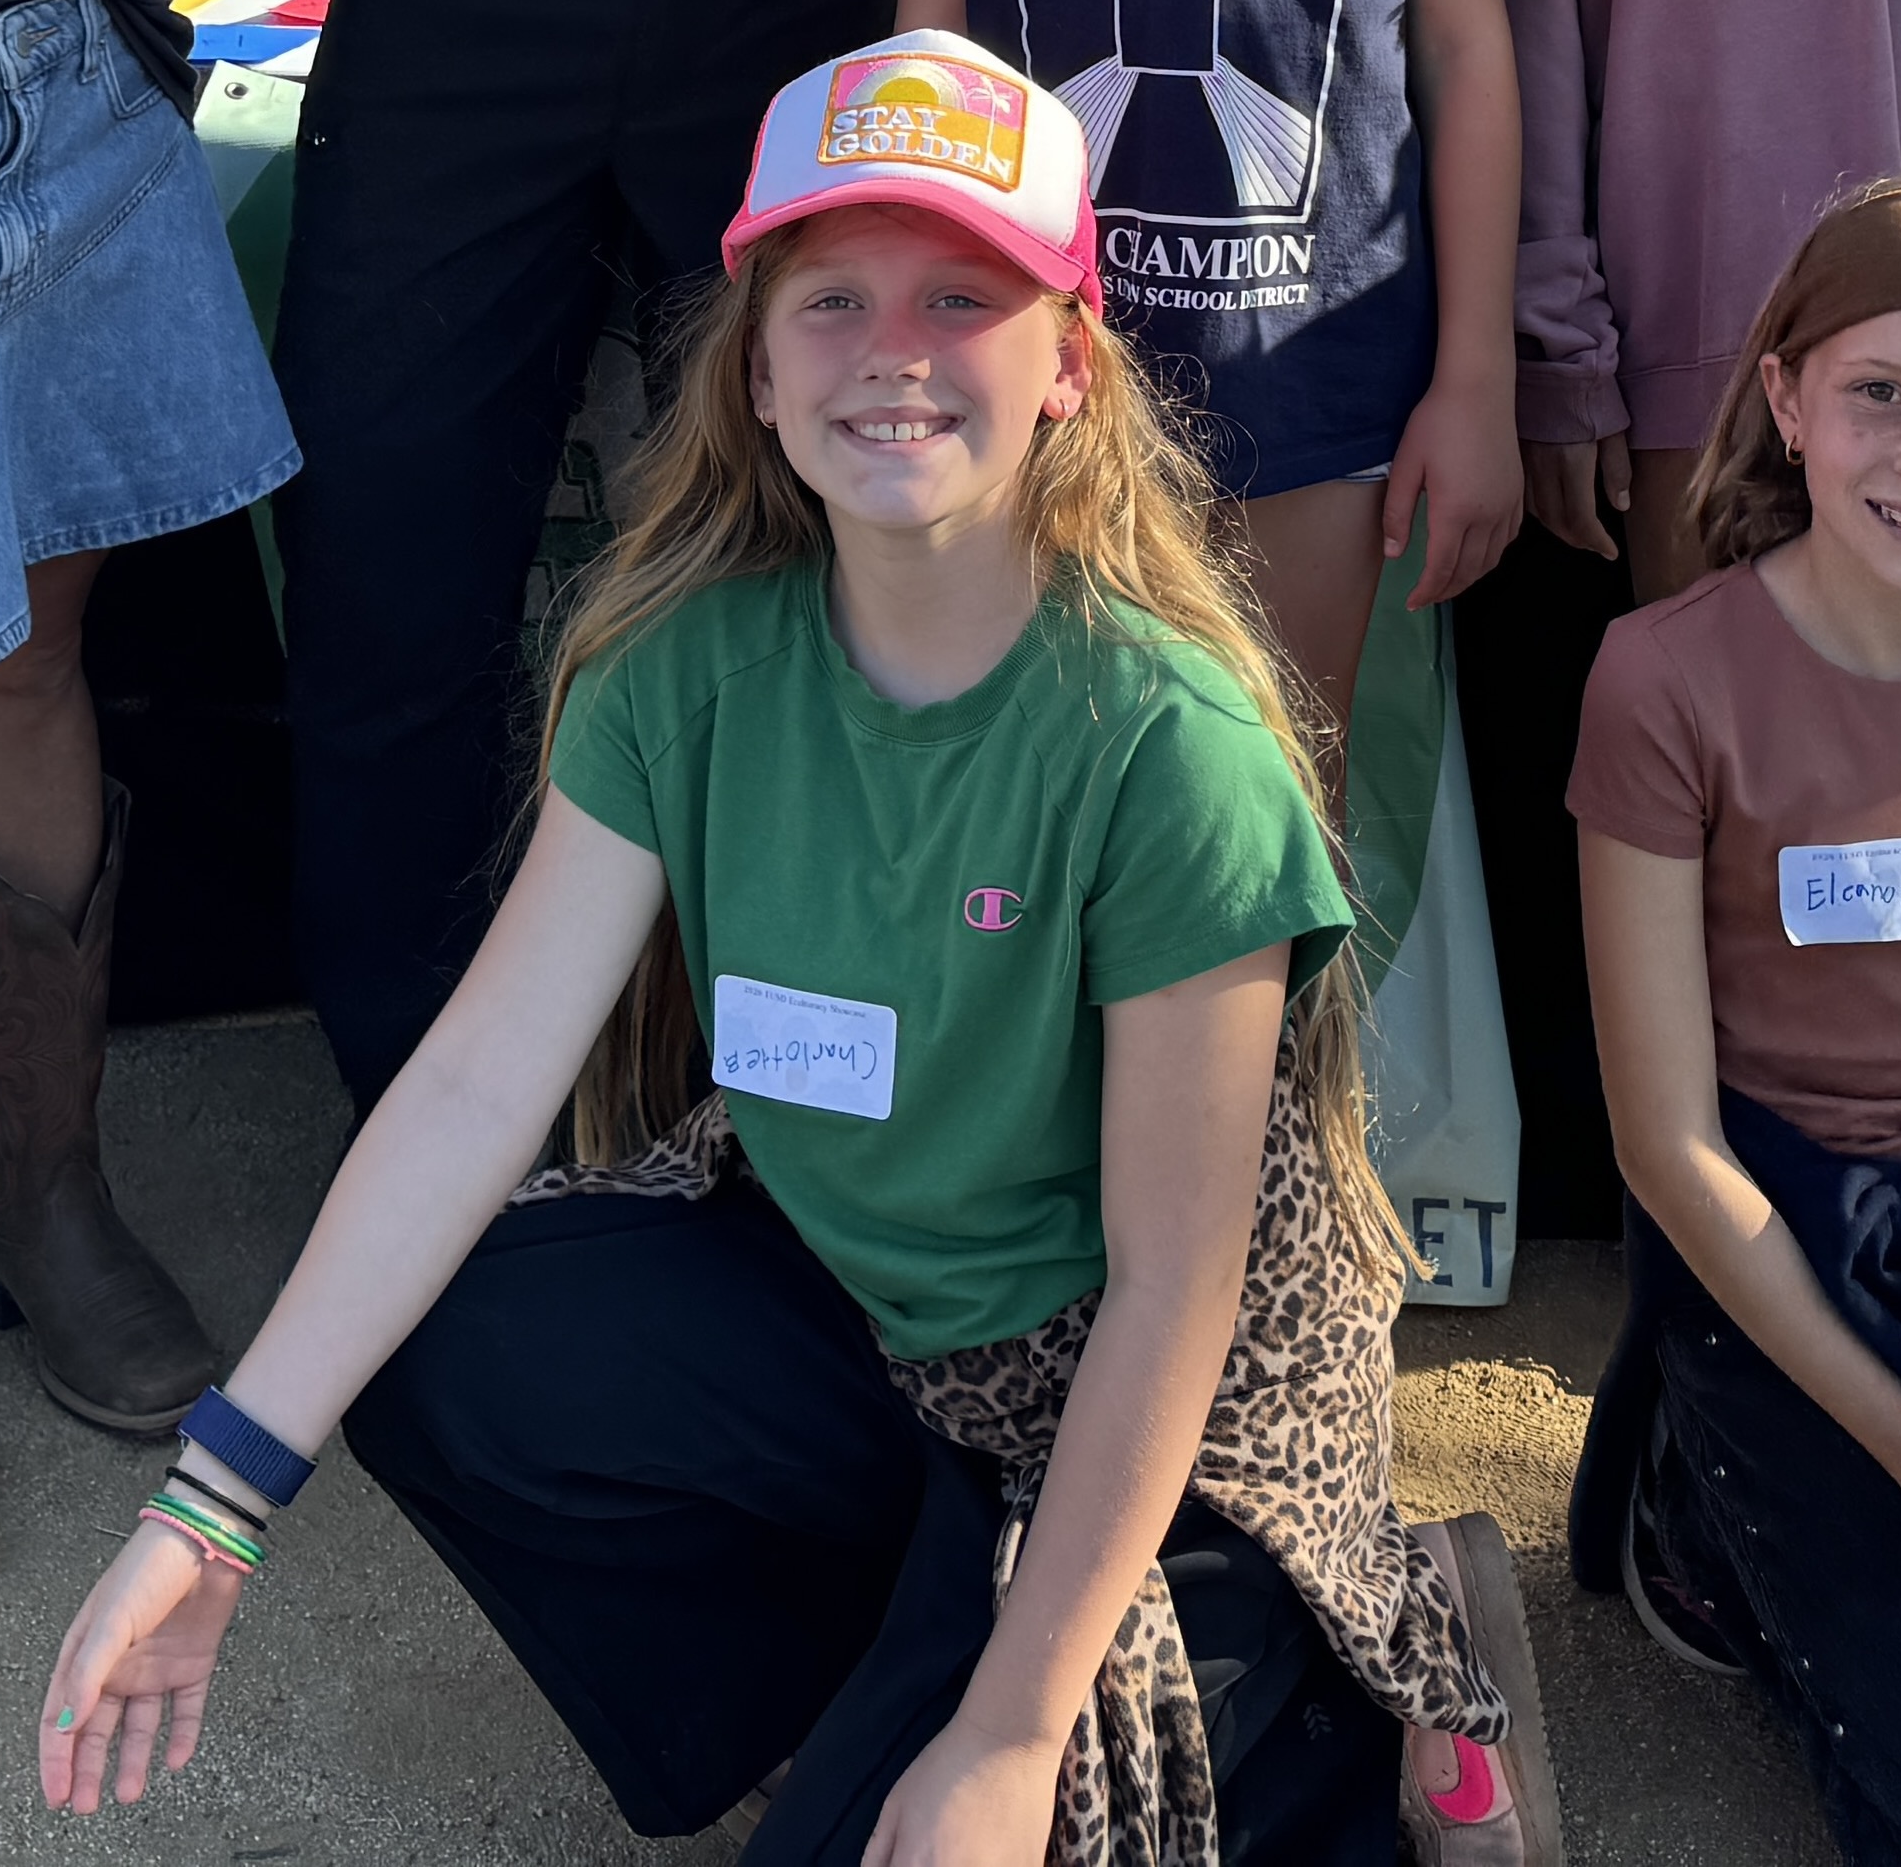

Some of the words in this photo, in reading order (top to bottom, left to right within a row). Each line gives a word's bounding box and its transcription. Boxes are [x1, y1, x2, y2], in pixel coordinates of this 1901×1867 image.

[831, 106, 947, 135] STAY
[827, 131, 1015, 183] GOLDEN
[1143, 287, 1237, 311] SCHOOL
[746, 1040, 877, 1080] Charlotte
[1409, 1197, 1507, 1288] ET
